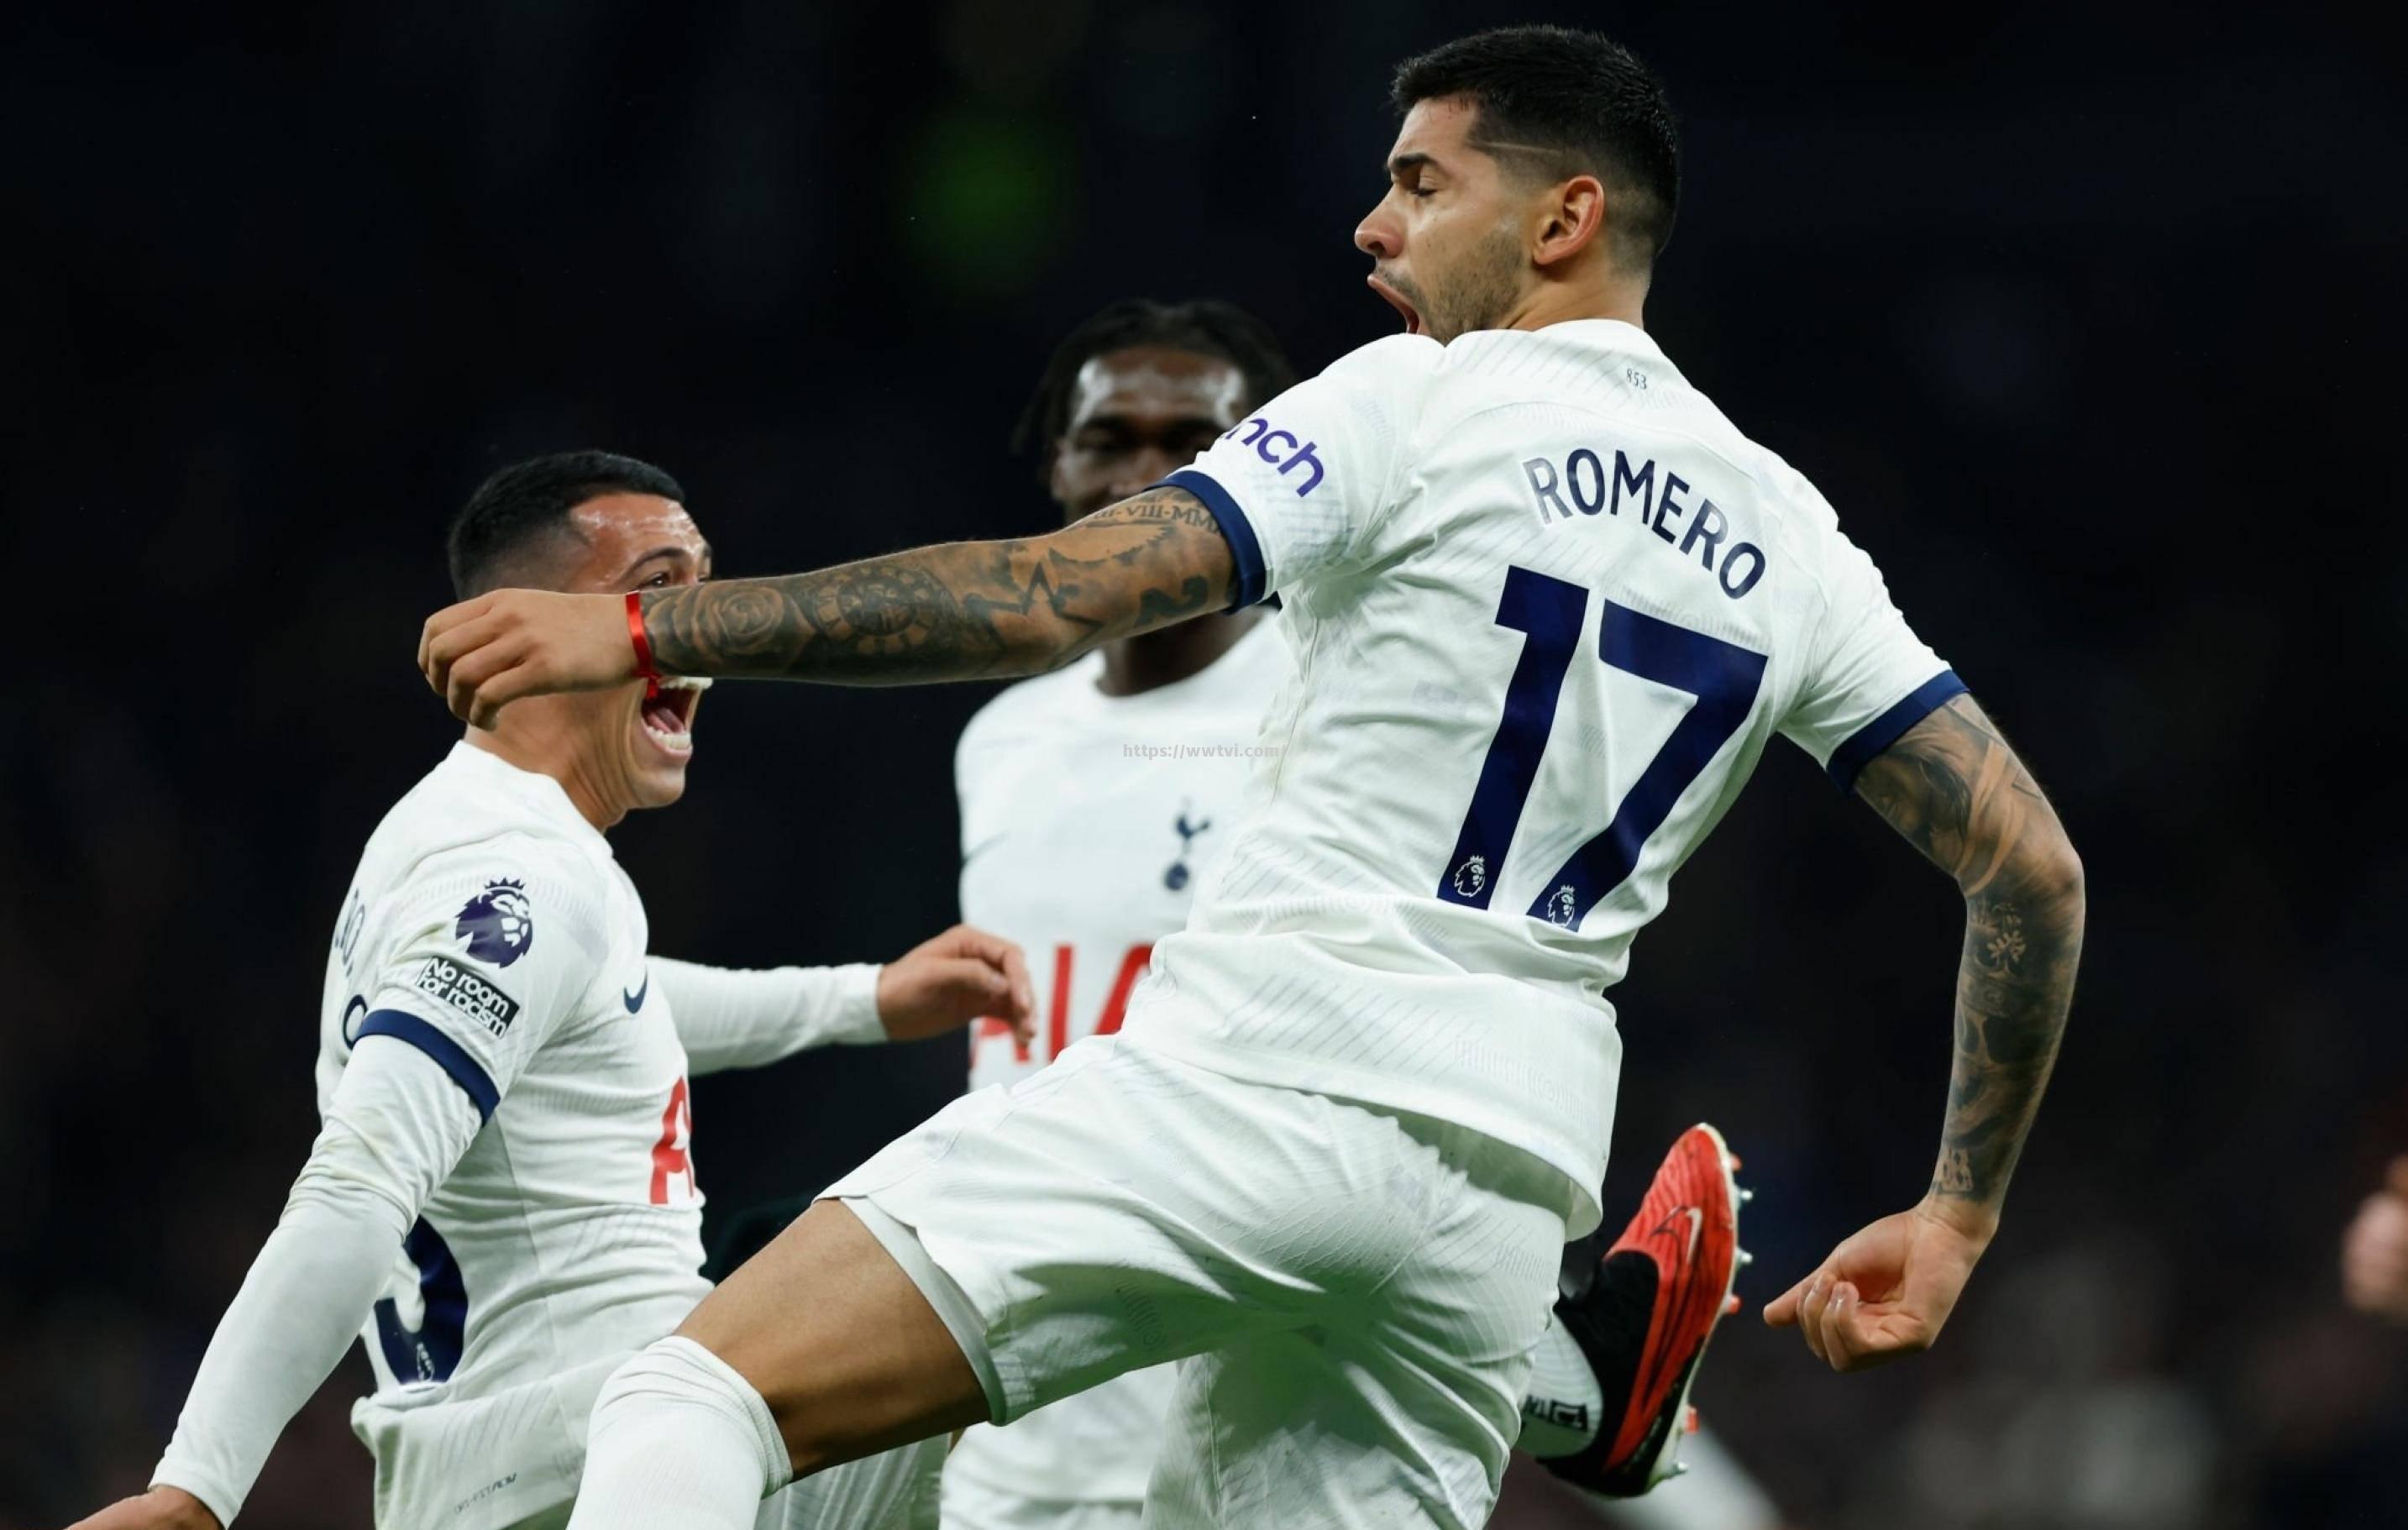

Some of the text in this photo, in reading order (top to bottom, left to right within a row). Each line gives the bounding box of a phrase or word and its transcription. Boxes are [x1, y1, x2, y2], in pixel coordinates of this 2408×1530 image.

[1626, 368, 1647, 390] 853
[1522, 448, 1766, 600] ROMERO
[1436, 564, 1769, 933] 17
[416, 974, 506, 1039] for racism
[423, 956, 509, 1018] No room
